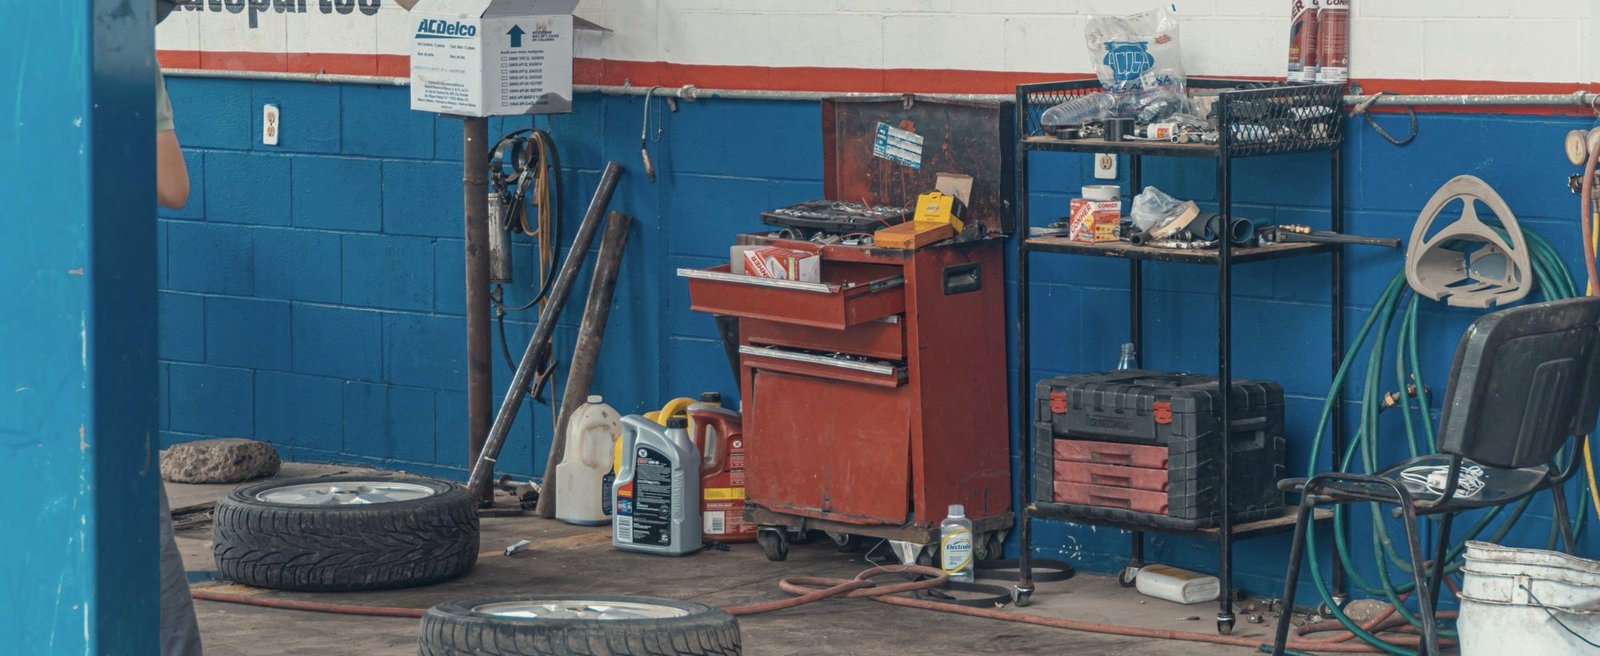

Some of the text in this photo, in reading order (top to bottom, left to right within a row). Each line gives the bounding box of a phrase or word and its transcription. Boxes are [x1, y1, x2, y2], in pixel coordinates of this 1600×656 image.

[417, 18, 477, 37] ACDelco
[1108, 51, 1150, 75] ACOSA
[1130, 75, 1171, 90] ACSA
[1070, 203, 1092, 233] CONNER
